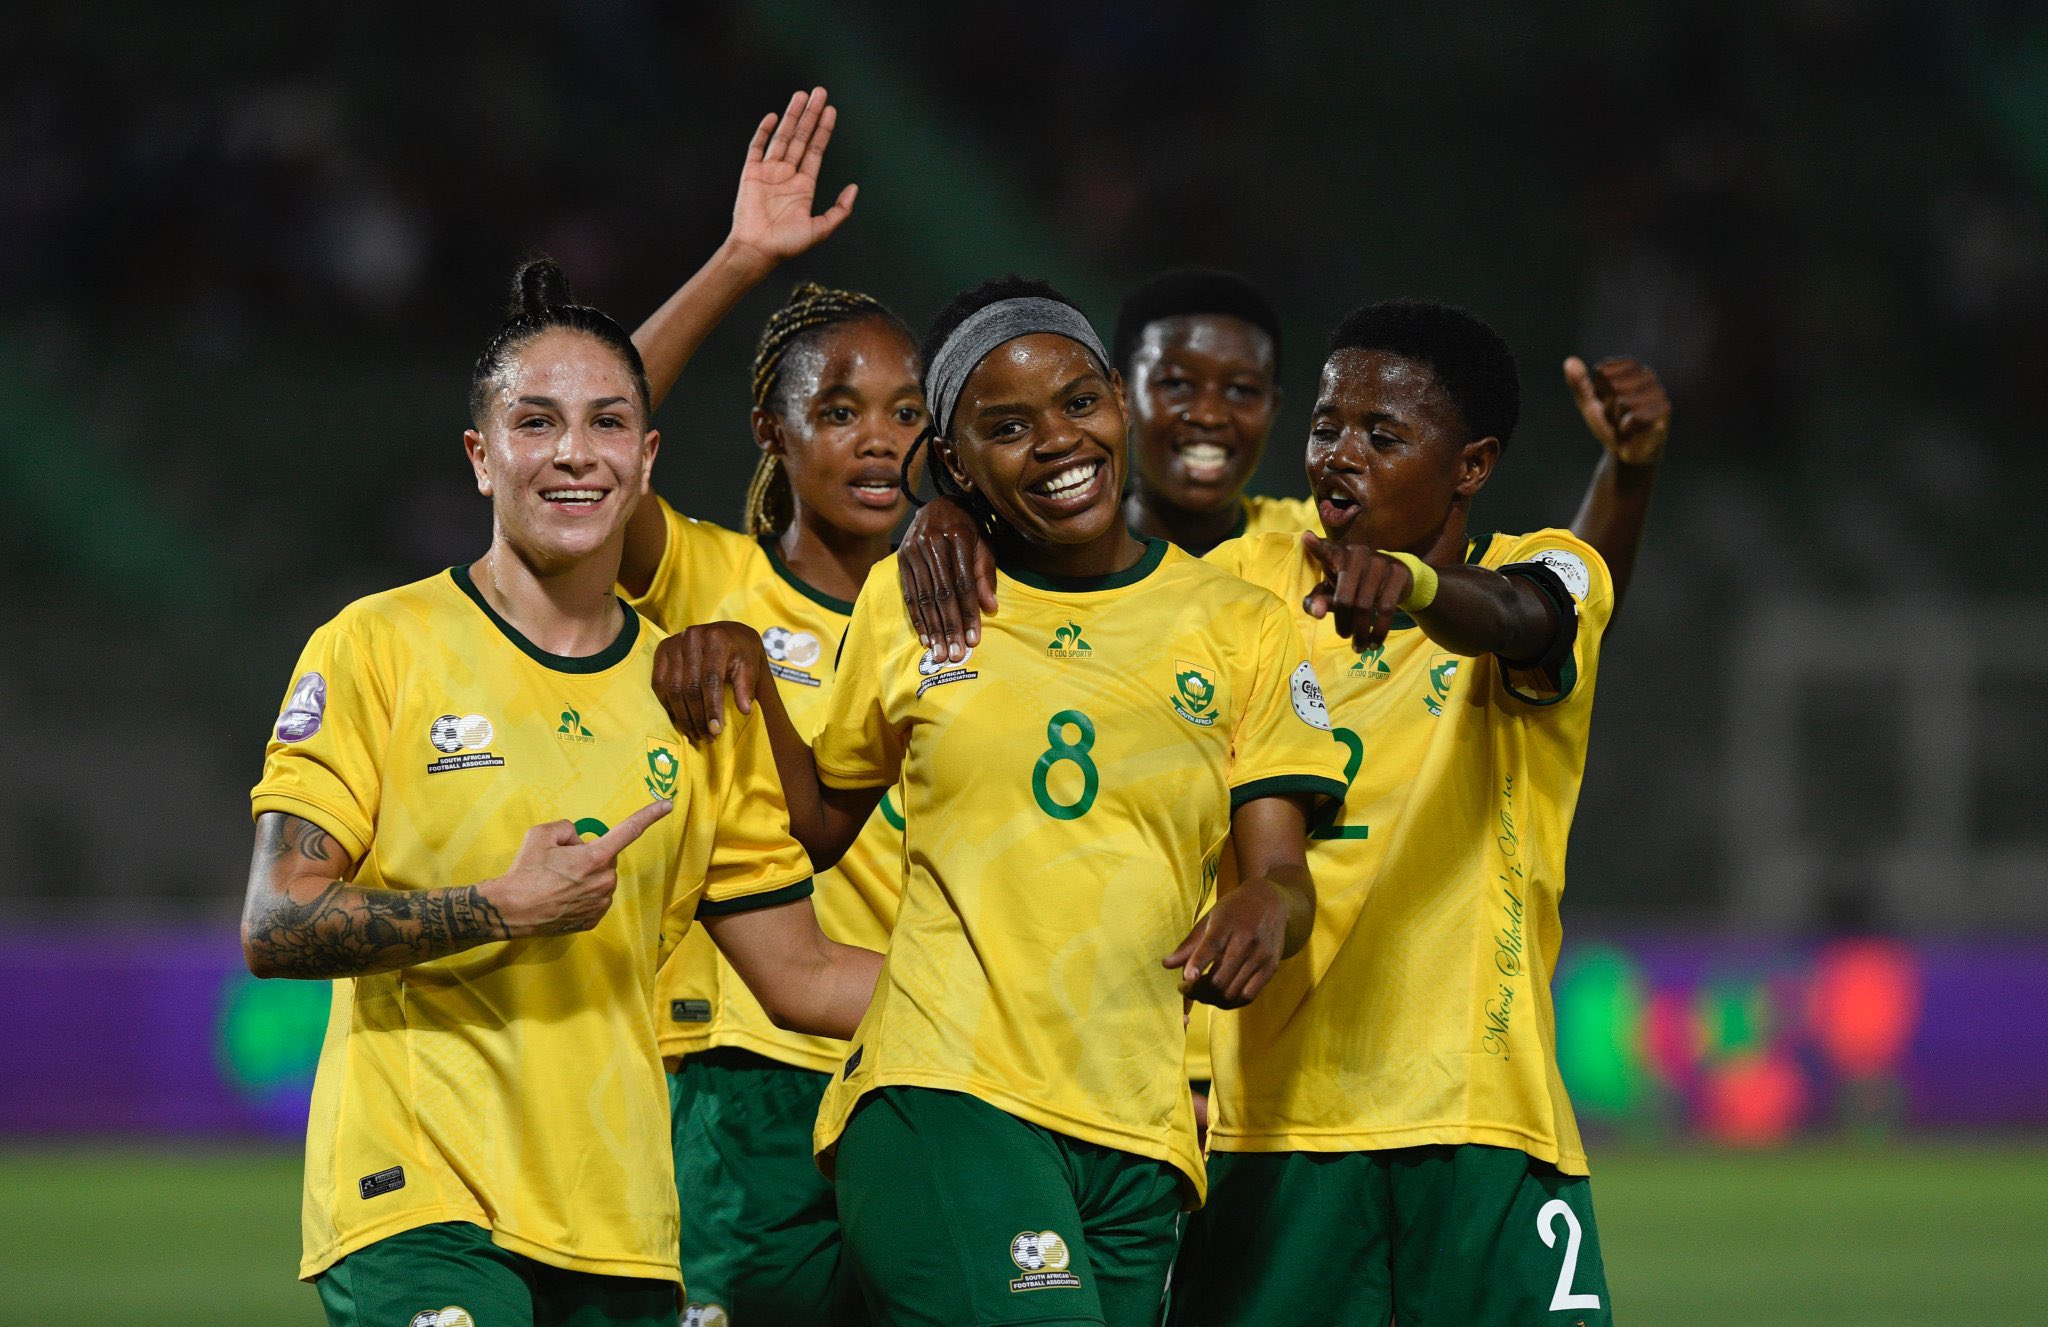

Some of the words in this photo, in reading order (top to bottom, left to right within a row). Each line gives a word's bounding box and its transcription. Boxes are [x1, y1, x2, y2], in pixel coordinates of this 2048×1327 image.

[1047, 649, 1053, 657] LE
[1068, 650, 1092, 658] SPORTIF
[937, 673, 977, 685] ASSOCIATION
[939, 669, 966, 679] AFRICAN
[1348, 669, 1354, 677] LE
[1302, 680, 1323, 694] Celeb
[1309, 700, 1326, 710] CA
[1176, 707, 1195, 722] SOUTH
[428, 763, 461, 773] FOOTBALL
[461, 759, 504, 768] ASSOCIATION
[440, 757, 462, 765] SOUTH
[462, 754, 491, 762] AFRICAN
[1032, 709, 1099, 820] 8
[1310, 727, 1369, 840] 2
[1482, 983, 1515, 1062] Nkosi
[1536, 1198, 1601, 1311] 2
[1013, 1280, 1046, 1289] FOOTBALL
